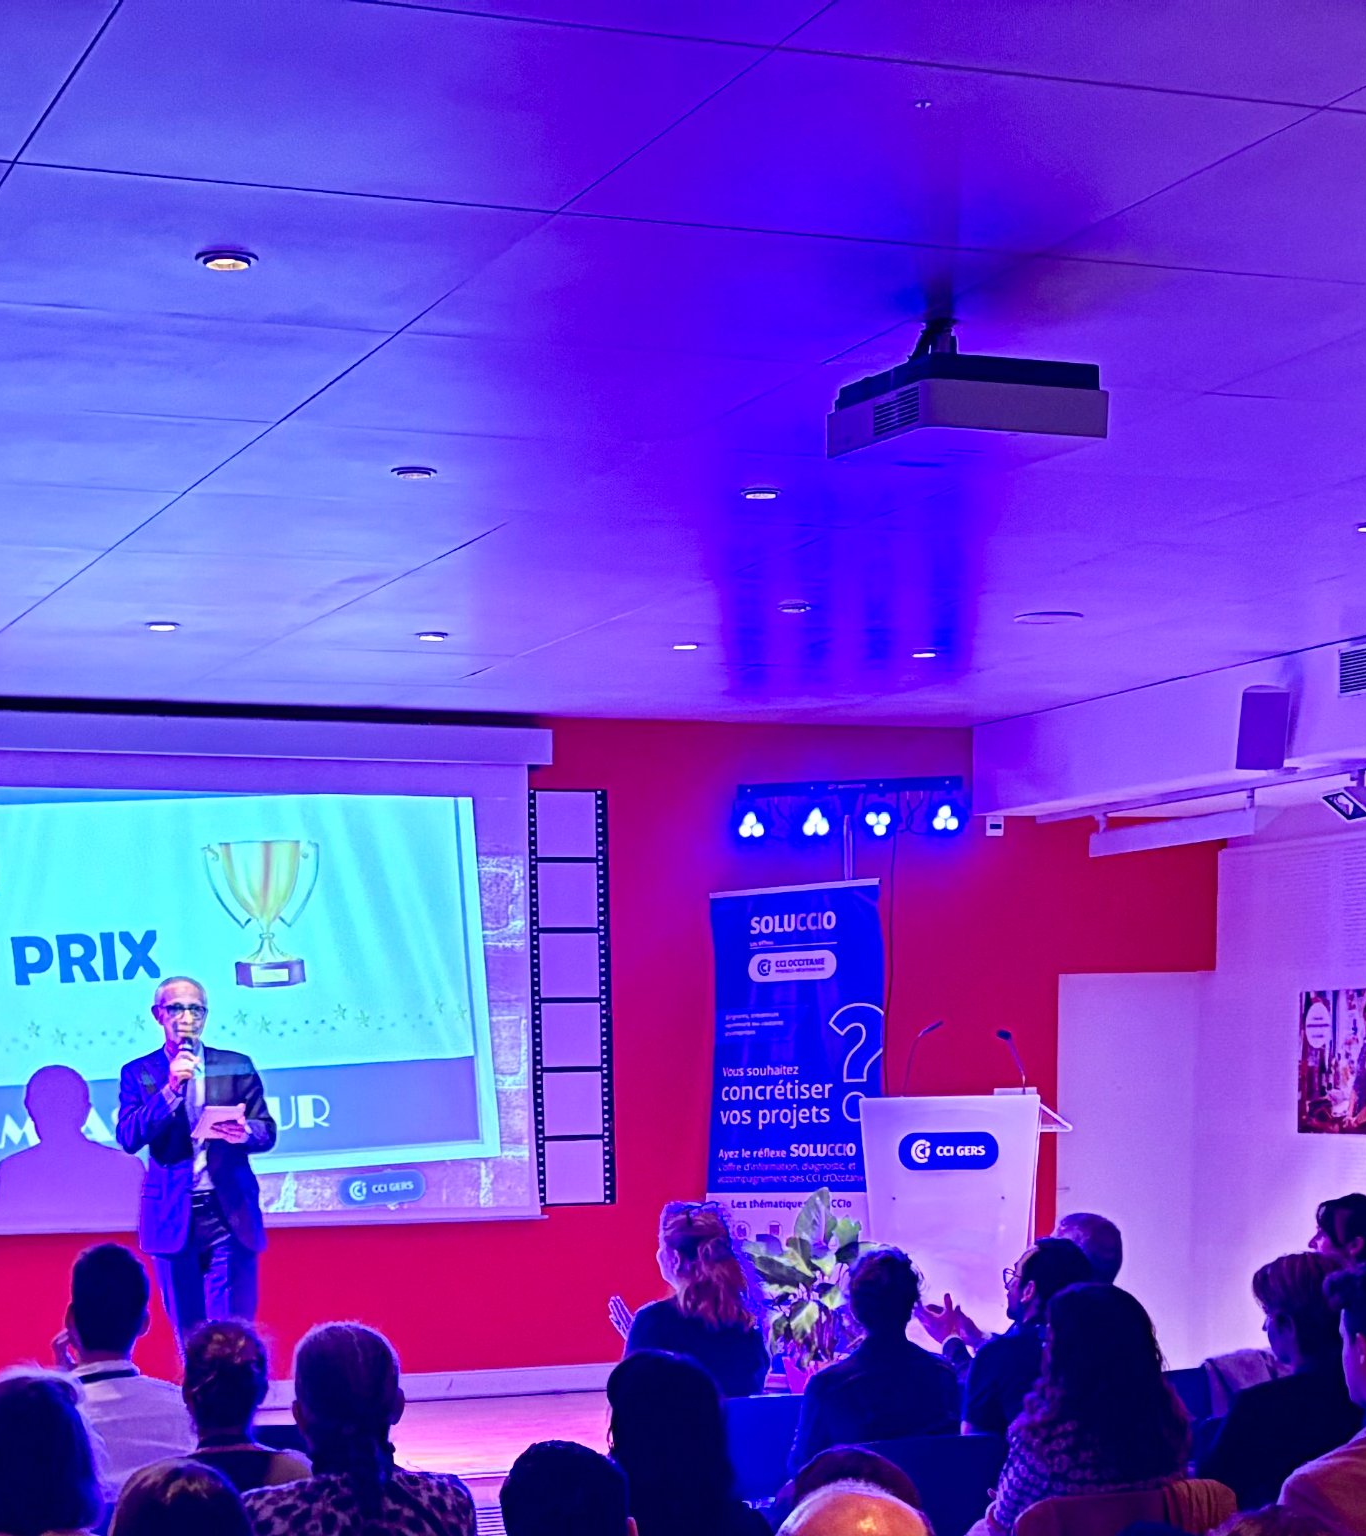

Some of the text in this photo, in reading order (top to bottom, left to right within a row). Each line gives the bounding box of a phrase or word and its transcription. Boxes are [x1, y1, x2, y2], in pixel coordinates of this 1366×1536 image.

[749, 911, 836, 935] SOLUCCIO
[10, 929, 161, 986] PRIX
[722, 1064, 799, 1077] Vous souhaitez
[721, 1079, 833, 1101] concrétiser
[720, 1104, 831, 1130] vos projets
[718, 1142, 857, 1161] Ayez le réflexe SOLUCCIO
[935, 1145, 986, 1157] CCI GERS
[805, 1173, 821, 1183] CCI
[371, 1181, 414, 1194] CCI GERS
[731, 1199, 747, 1209] Les
